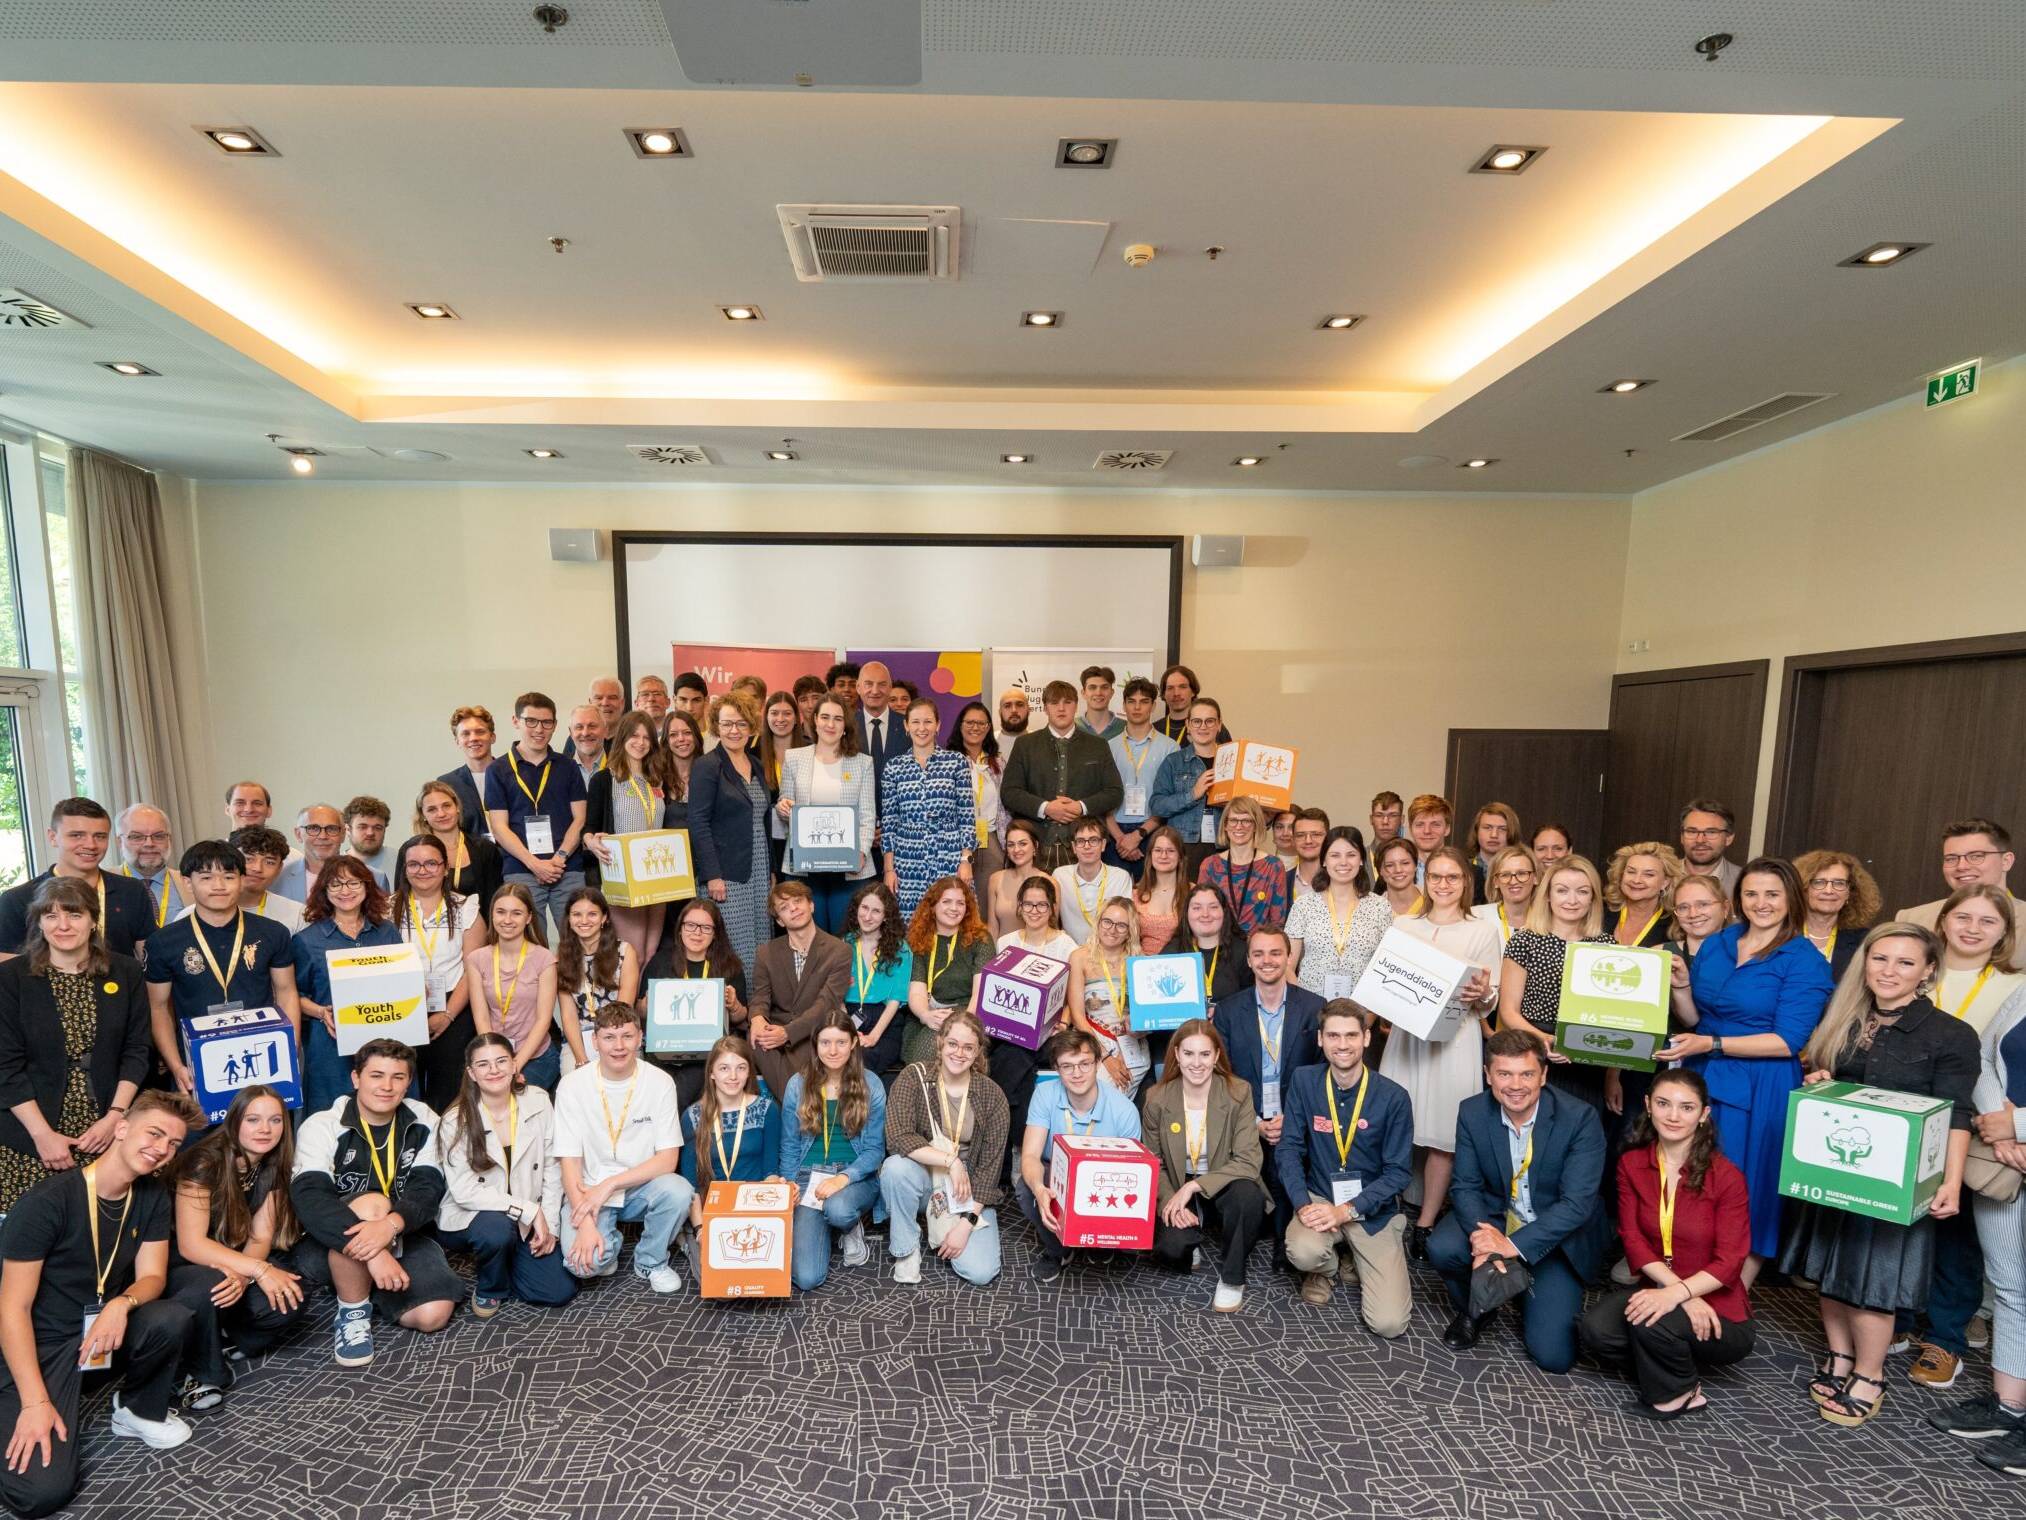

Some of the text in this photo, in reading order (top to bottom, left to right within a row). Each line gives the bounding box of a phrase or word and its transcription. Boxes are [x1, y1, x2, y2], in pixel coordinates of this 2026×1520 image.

[693, 665, 733, 683] Wir
[1378, 957, 1444, 997] Jugenddialog
[355, 1003, 394, 1016] Youth
[365, 1012, 402, 1024] Goals
[1580, 1013, 1598, 1024] #6
[985, 1026, 997, 1036] #2
[210, 1109, 228, 1122] #9
[1790, 1182, 1822, 1200] #10
[1826, 1190, 1871, 1205] SUSTAINABLE
[1872, 1200, 1898, 1212] GREEN
[1080, 1234, 1095, 1245] #5
[727, 1285, 742, 1296] #8
